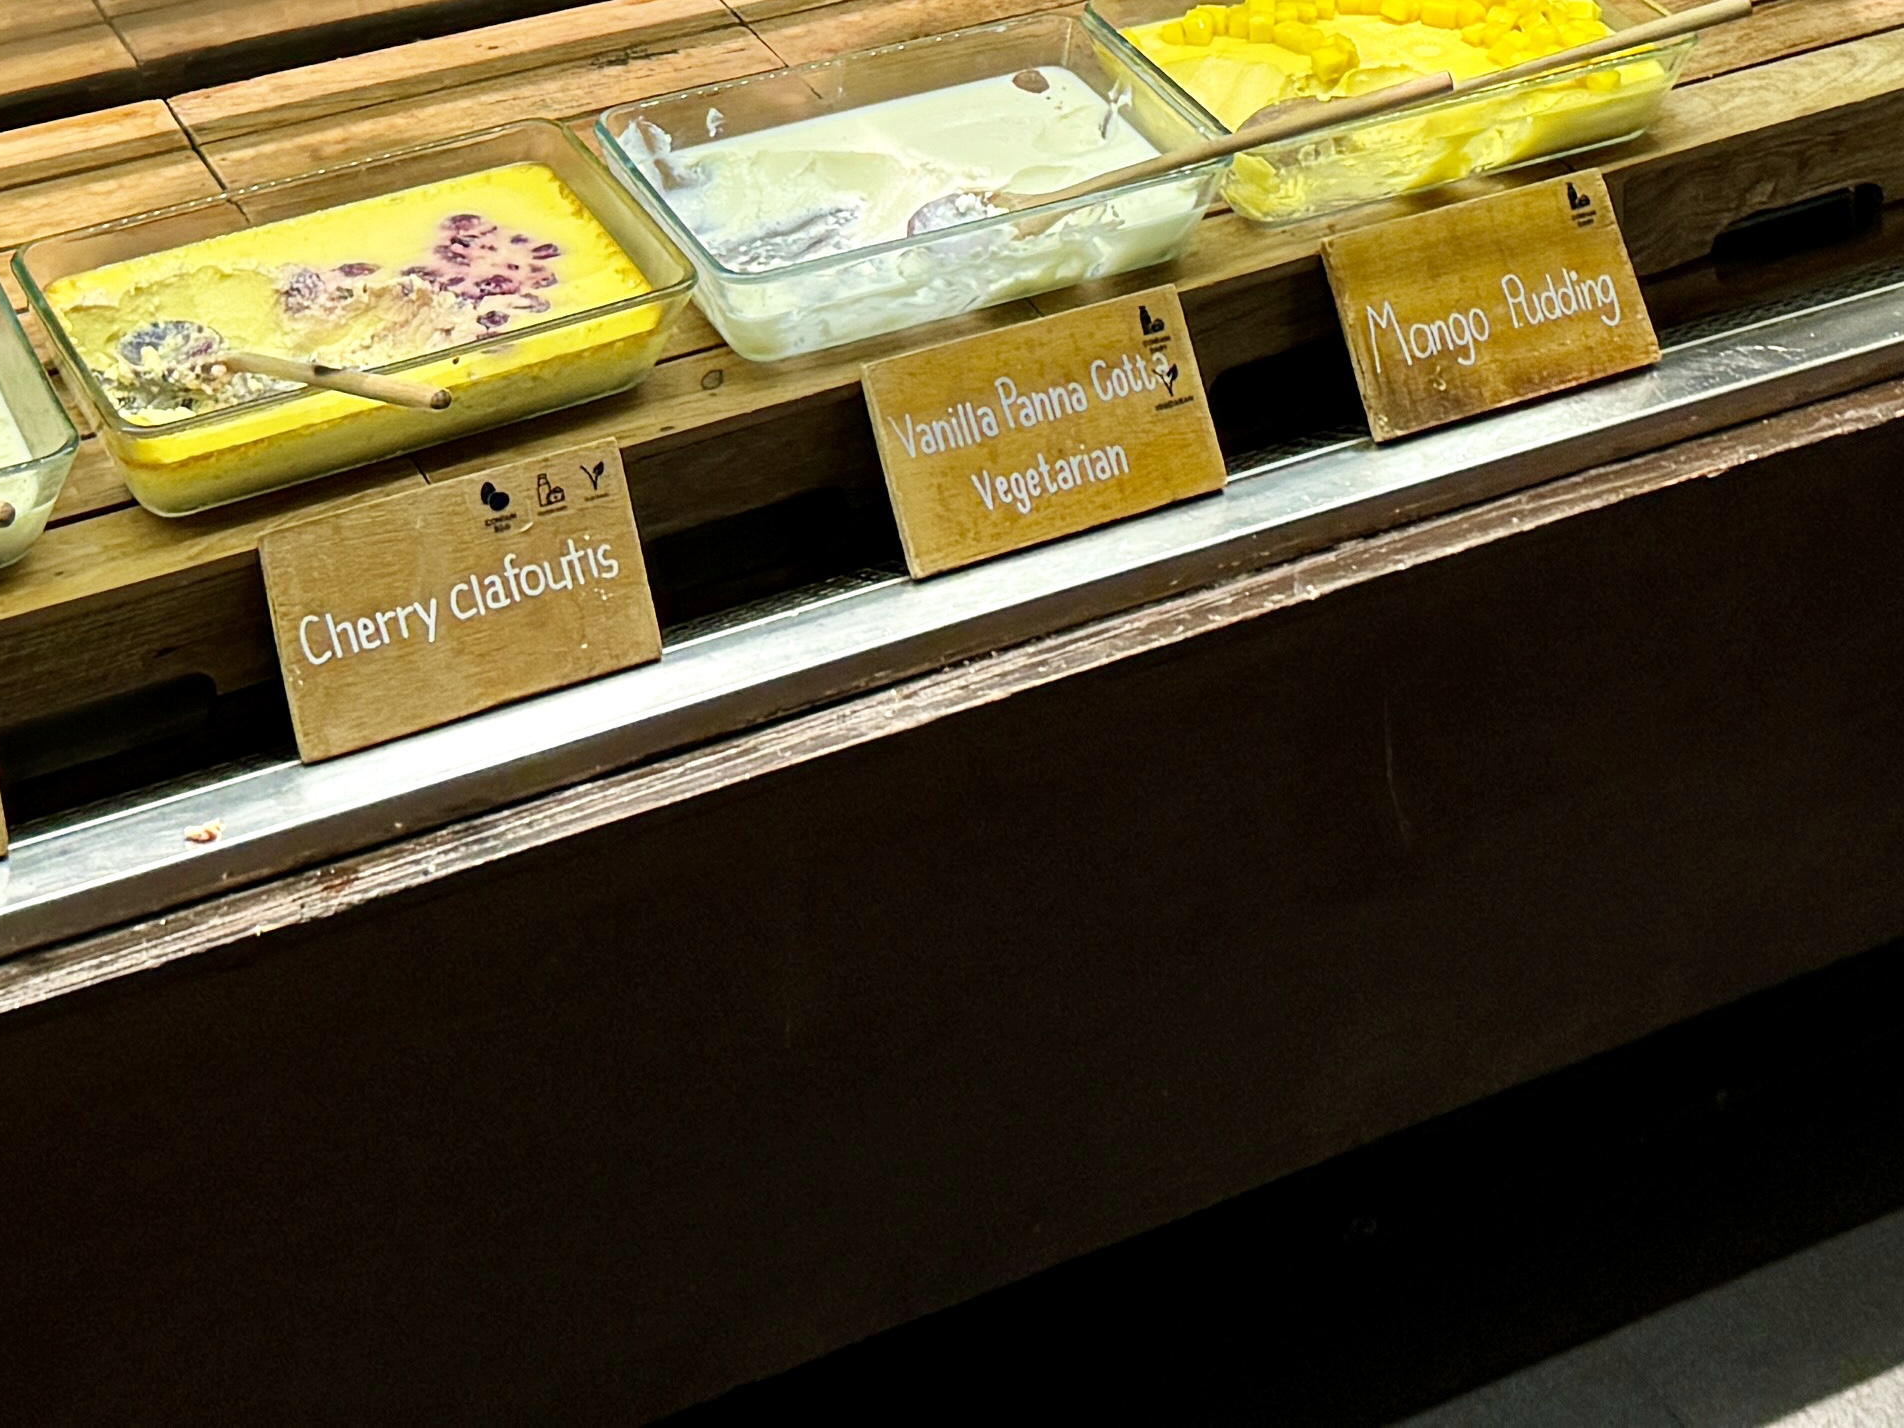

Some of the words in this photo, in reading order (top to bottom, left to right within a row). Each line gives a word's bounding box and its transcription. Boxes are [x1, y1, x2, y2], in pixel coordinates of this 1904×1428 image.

[1365, 299, 1492, 375] Mango
[1500, 266, 1622, 329] Pudding
[887, 400, 1001, 459] Vanilla
[994, 375, 1089, 430] Panna
[1090, 350, 1173, 403] Cotta
[970, 443, 1130, 515] Vegetarian
[298, 597, 439, 667] Cherry
